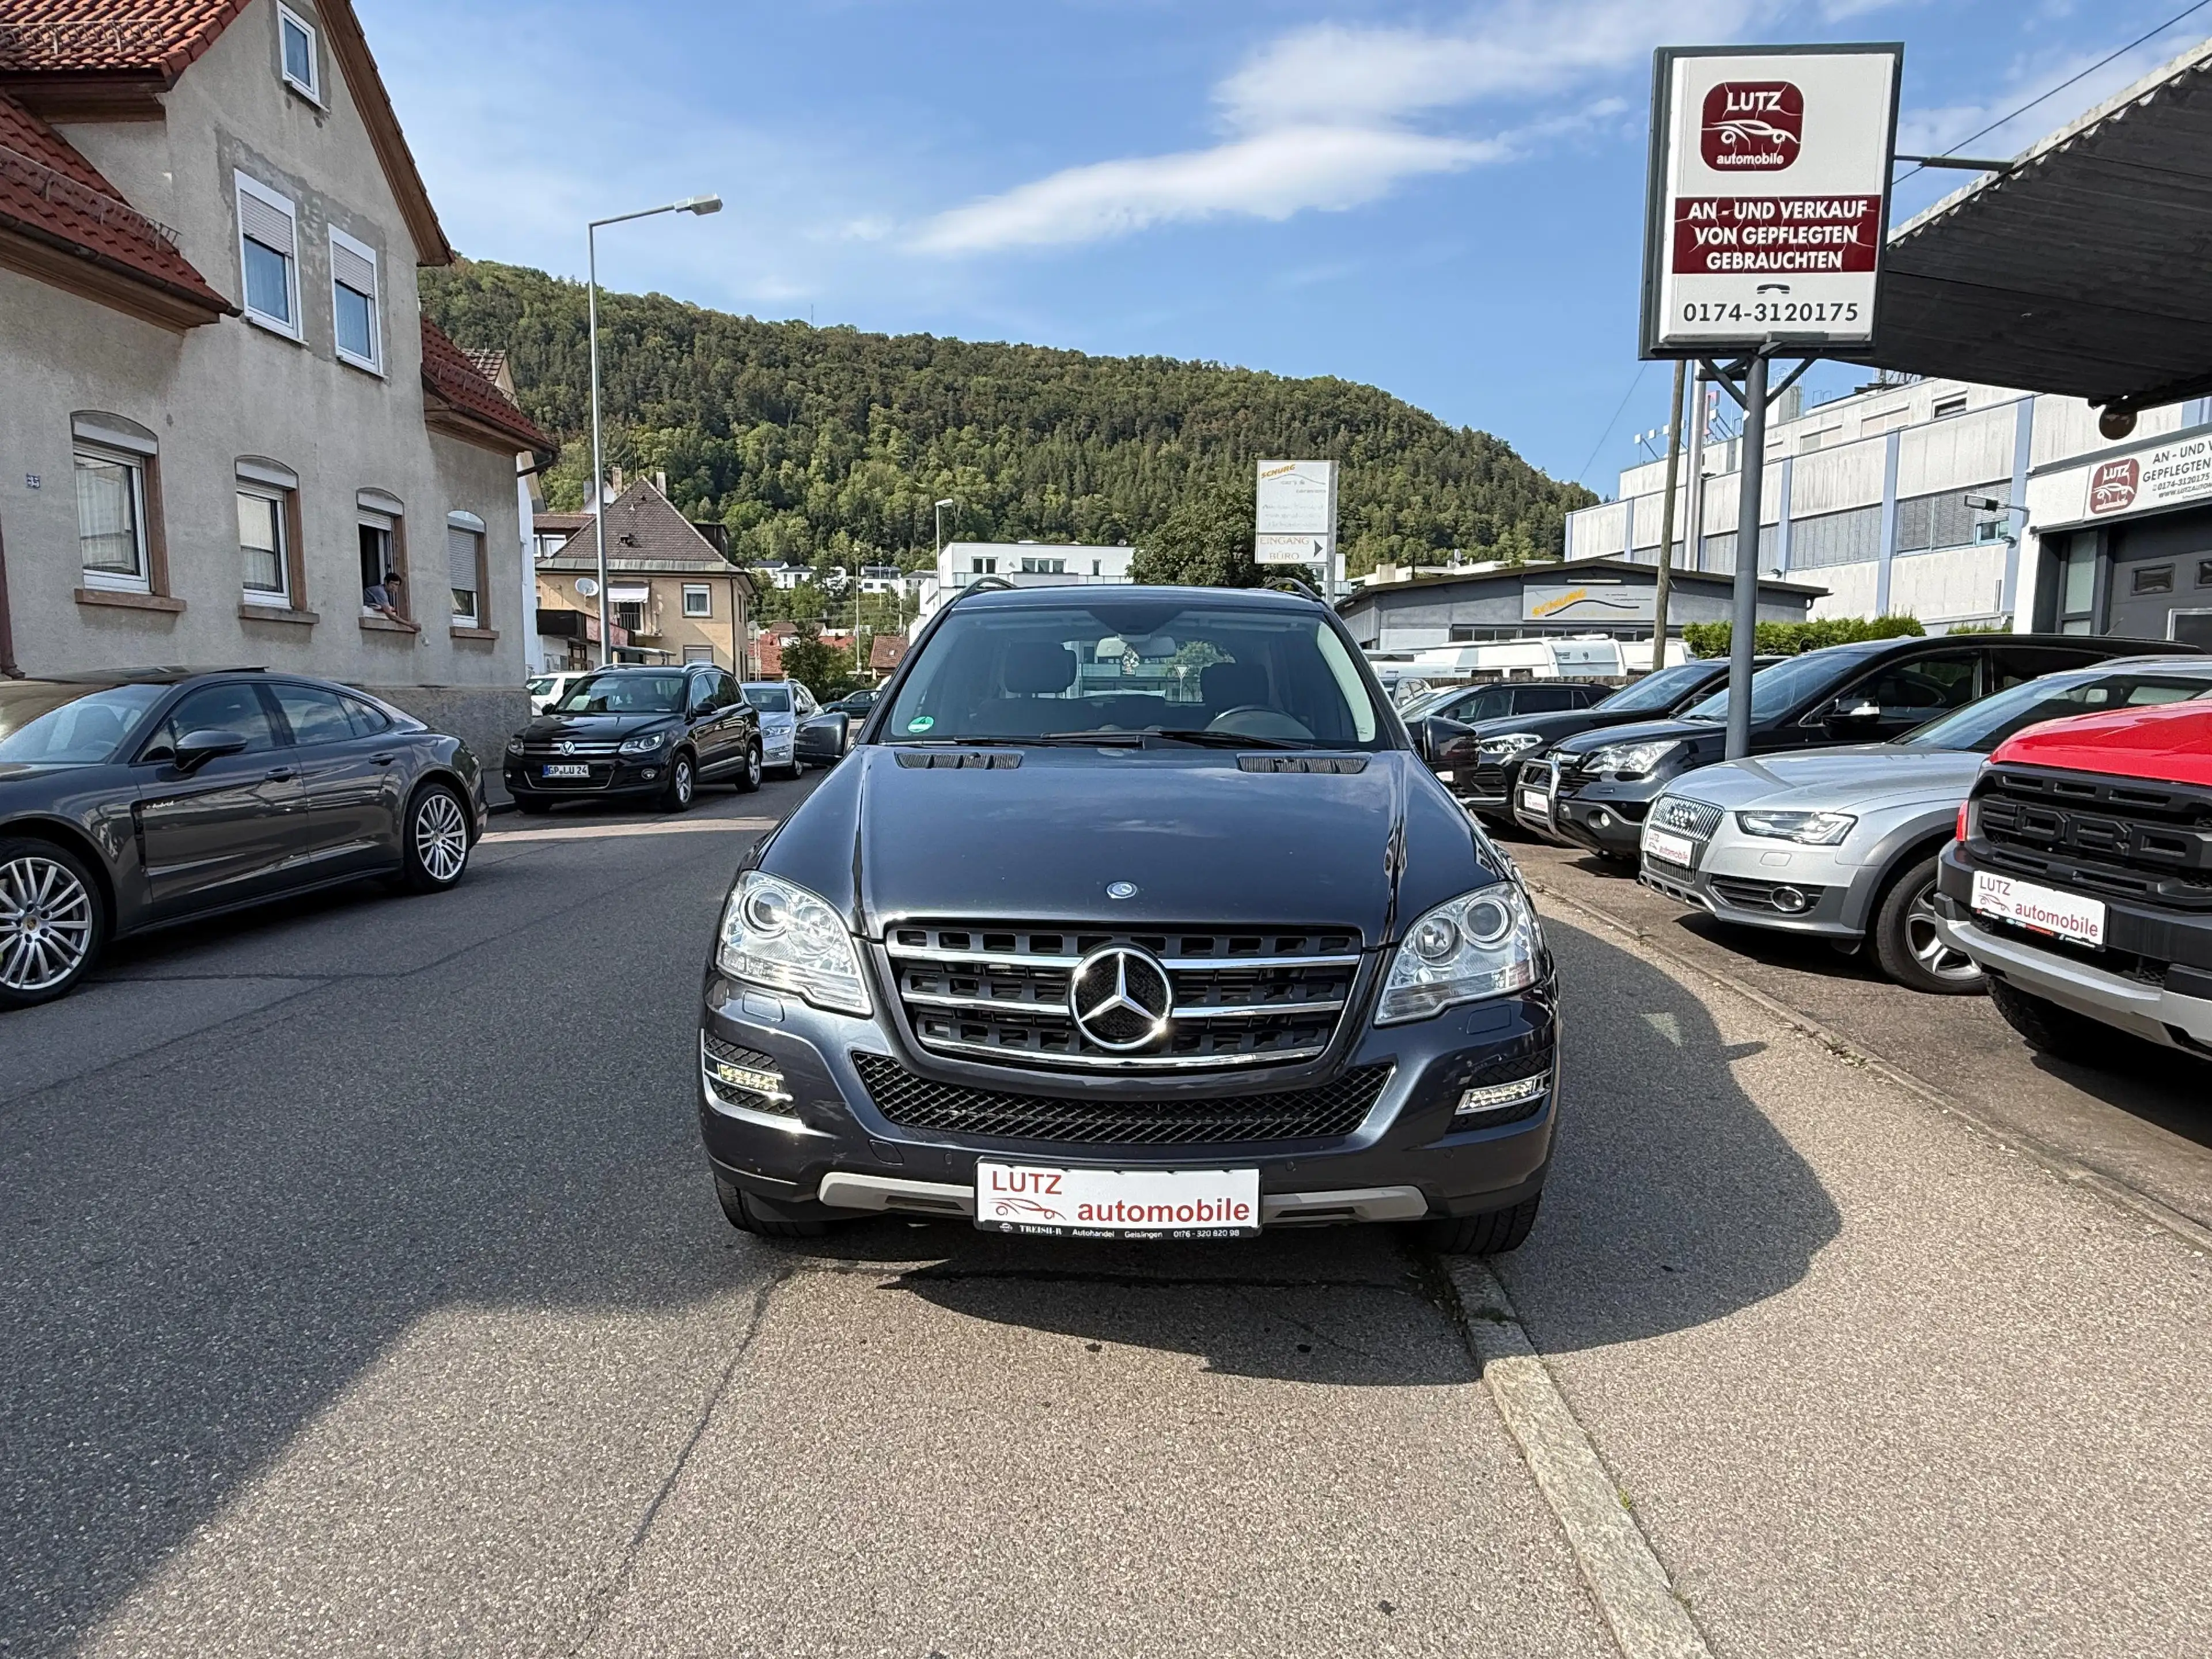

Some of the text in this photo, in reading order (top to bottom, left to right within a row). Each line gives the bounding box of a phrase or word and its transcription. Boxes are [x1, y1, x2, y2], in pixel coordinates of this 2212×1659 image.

[1728, 91, 1782, 111] LUTZ
[1716, 152, 1784, 165] automobile
[1687, 202, 1717, 220] AN
[1734, 202, 1775, 219] UND
[1780, 200, 1868, 219] VERKAUF
[1695, 225, 1858, 245] VON GEPFLEGTEN
[1706, 251, 1842, 270] GEBRAUCHTEN
[1683, 302, 1858, 322] 0174-3120175
[2153, 449, 2170, 465] AN
[2180, 442, 2206, 458] UND
[2104, 464, 2130, 481] LUTZ
[2142, 456, 2212, 483] GEPFLEGTEN
[1260, 536, 1309, 545] EINGANG
[1269, 551, 1300, 560] BÜRO
[1980, 876, 2011, 896] LUTZ
[2016, 903, 2099, 937] automobile
[992, 1171, 1062, 1195] LUTZ
[1078, 1198, 1250, 1222] automobile
[1072, 1228, 1115, 1238] Autohandel
[1124, 1230, 1163, 1239] Geislingen
[1173, 1230, 1191, 1238] 0176
[1196, 1230, 1211, 1238] 320
